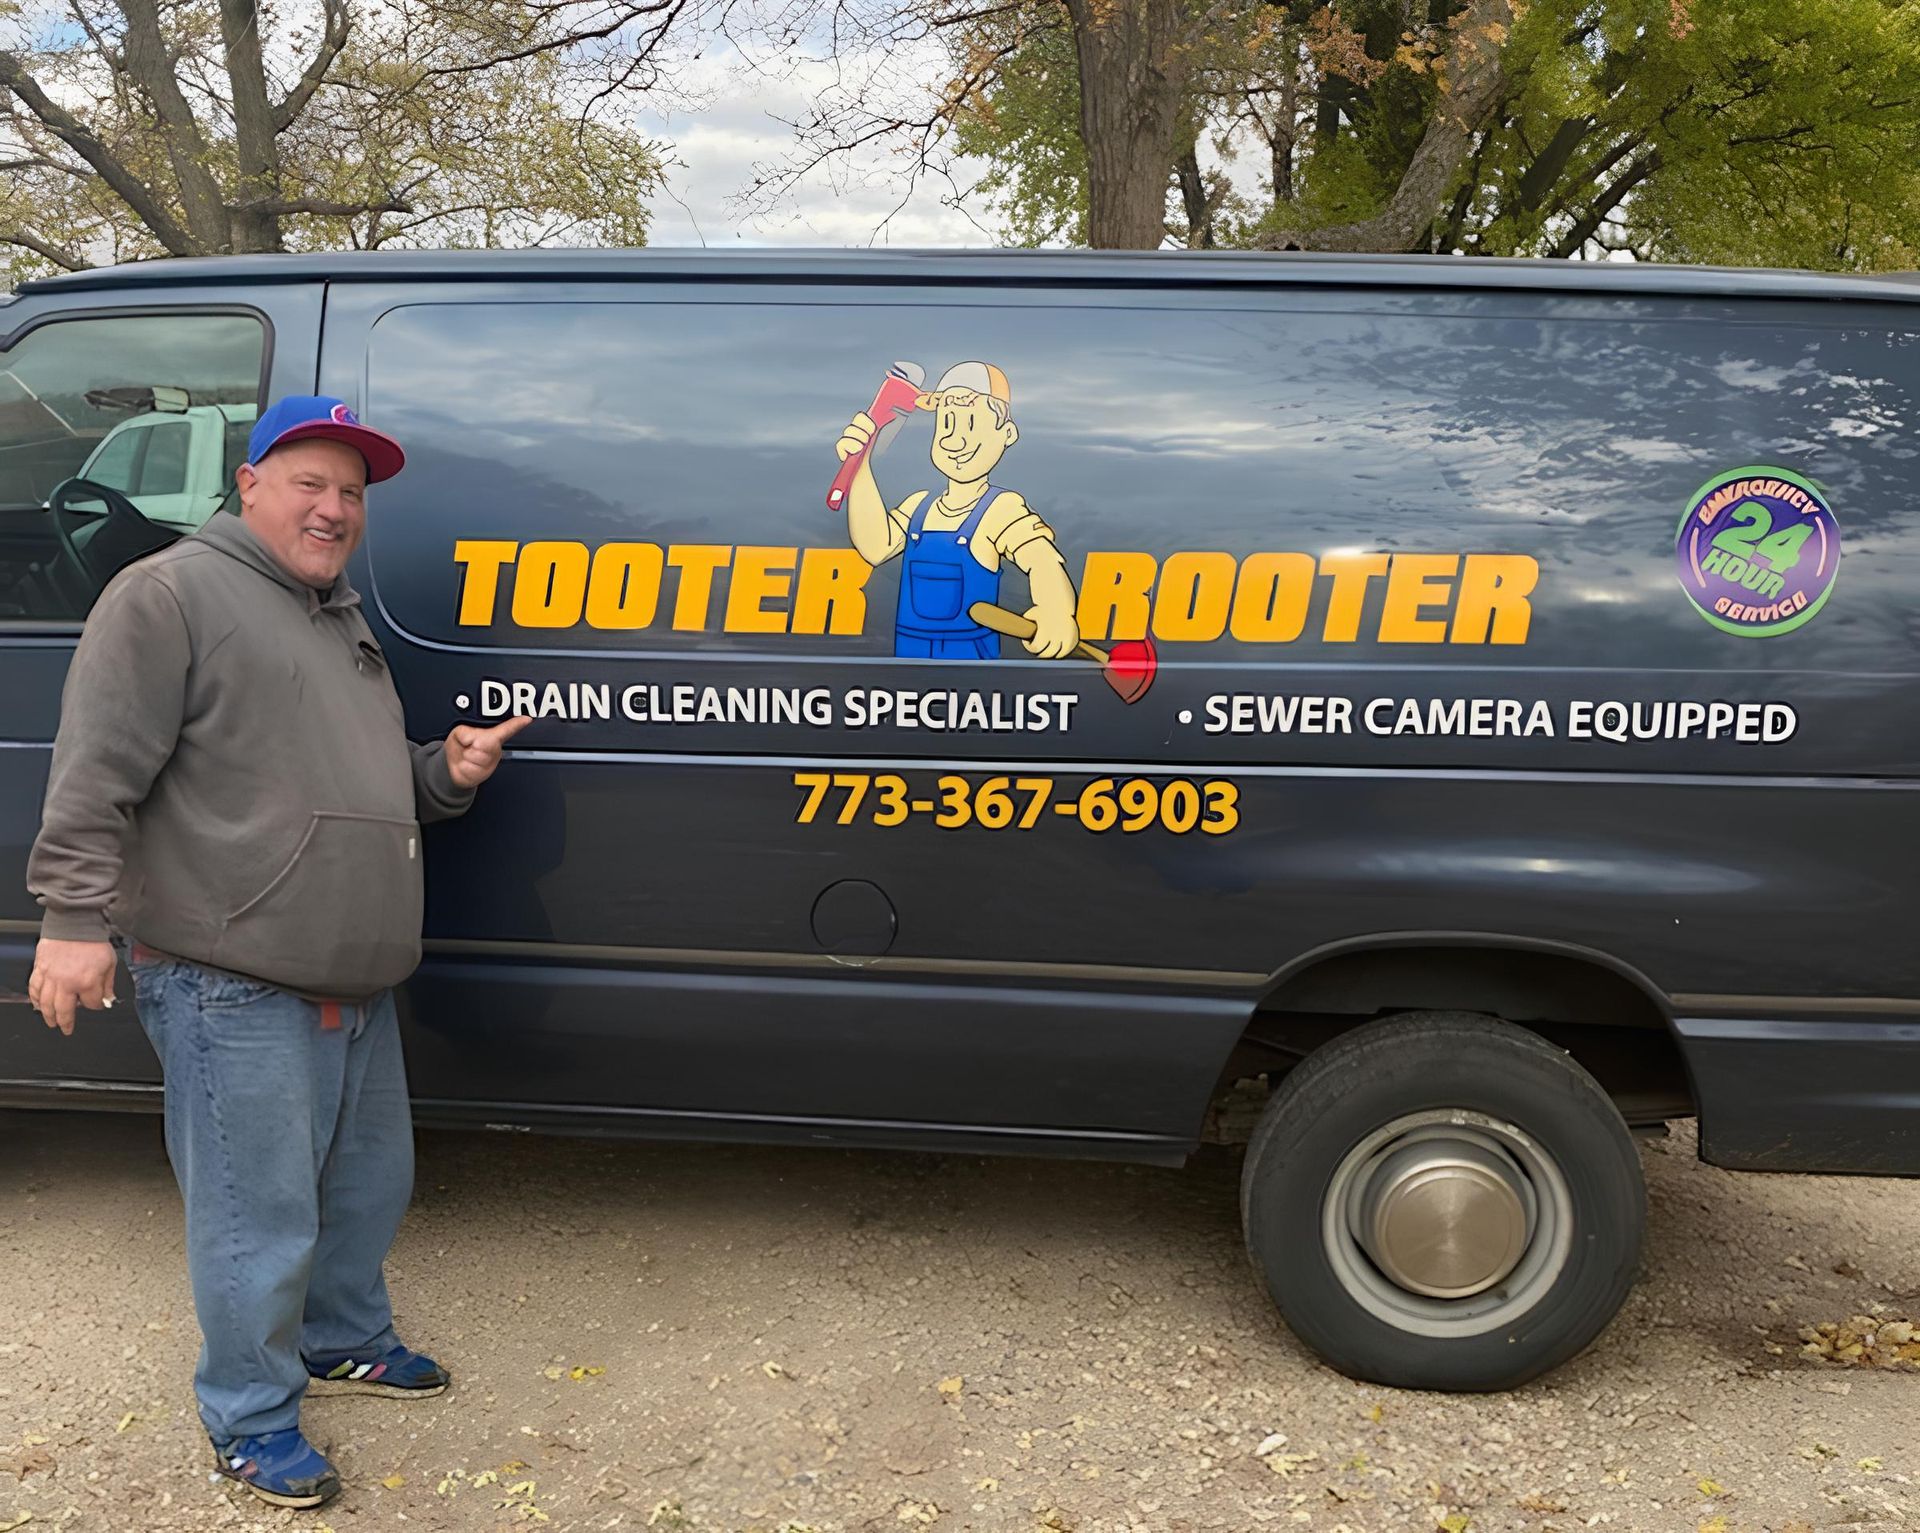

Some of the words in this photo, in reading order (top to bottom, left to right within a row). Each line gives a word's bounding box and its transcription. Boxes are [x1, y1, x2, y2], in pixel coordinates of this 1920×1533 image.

[1711, 501, 1814, 573] 24
[454, 540, 873, 635] TOOTER
[1076, 552, 1538, 645] ROOTER
[1701, 548, 1785, 600] HOUR
[481, 680, 610, 720] DRAIN
[621, 685, 832, 725] CLEANING
[844, 689, 1078, 731] SPECIALIST
[1204, 695, 1353, 734] SEWER
[1364, 697, 1555, 738] CAMERA
[1568, 700, 1796, 743] EQUIPPED
[794, 773, 1238, 834] 773-367-6903
